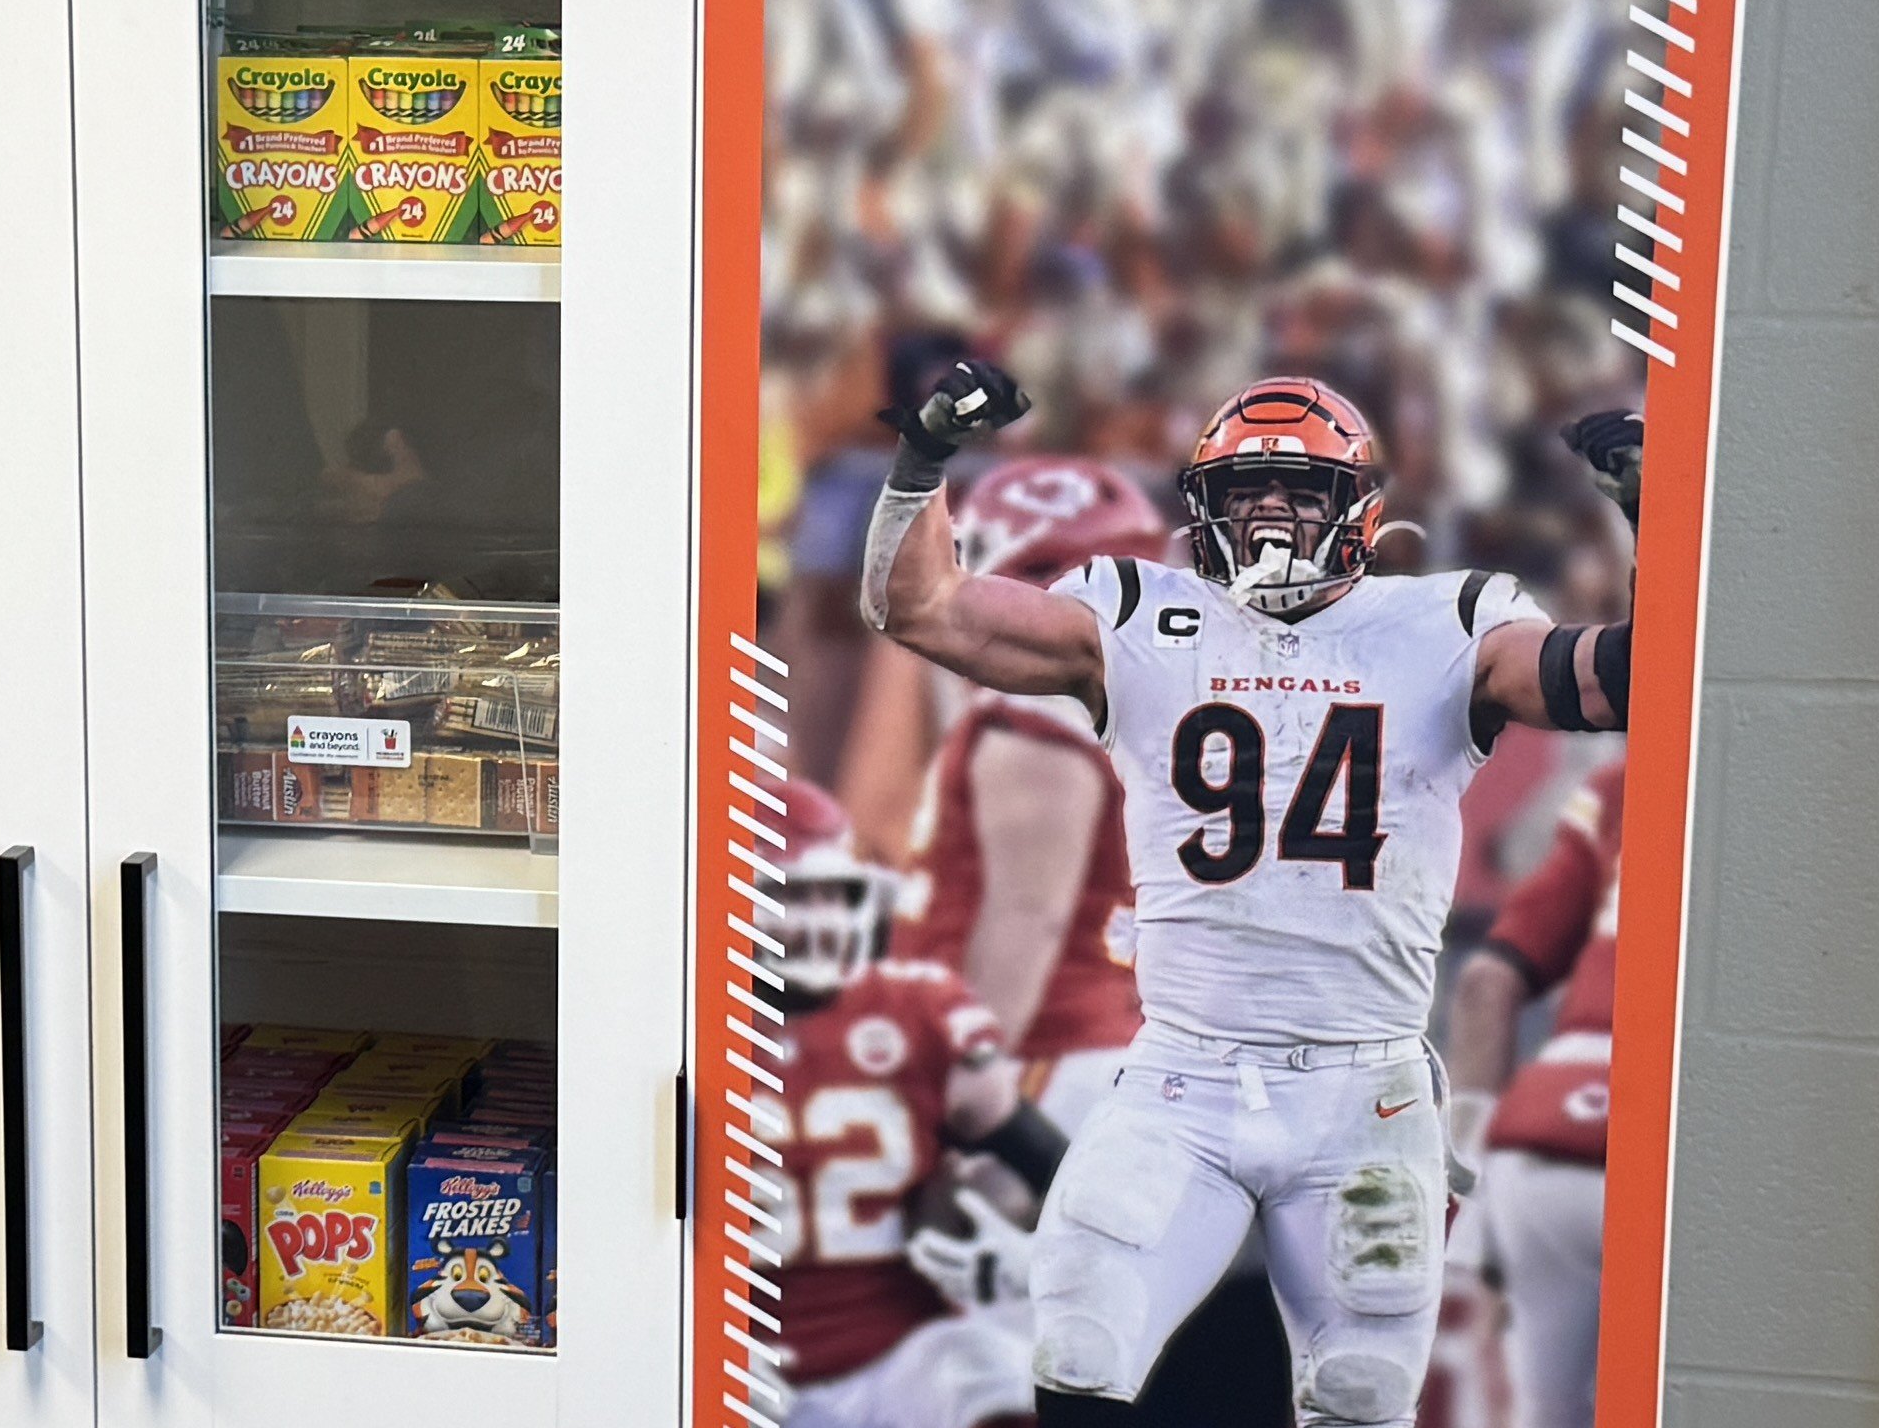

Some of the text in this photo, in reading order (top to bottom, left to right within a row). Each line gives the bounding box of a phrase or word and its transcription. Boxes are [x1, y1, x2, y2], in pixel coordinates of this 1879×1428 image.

[501, 34, 526, 52] 24
[235, 66, 326, 91] Crayola
[367, 66, 457, 92] Crayola
[239, 134, 326, 151] #1 Brand Preferred
[369, 134, 457, 152] #1 Brand Preferred
[501, 140, 516, 157] #1
[517, 139, 545, 148] Brand
[226, 161, 338, 193] CRAYONS
[355, 161, 467, 194] CRAYONS
[271, 201, 293, 219] 24
[401, 203, 424, 220] 24
[532, 207, 554, 225] 24
[1157, 607, 1201, 637] C
[1210, 676, 1361, 694] BENGALS
[309, 730, 358, 742] crayons
[309, 742, 325, 750] and
[283, 768, 297, 815] Austin
[1169, 702, 1388, 892] 94
[423, 1198, 521, 1221] FROSTED
[428, 1216, 512, 1239] FLAKES
[266, 1212, 378, 1277] POPS
